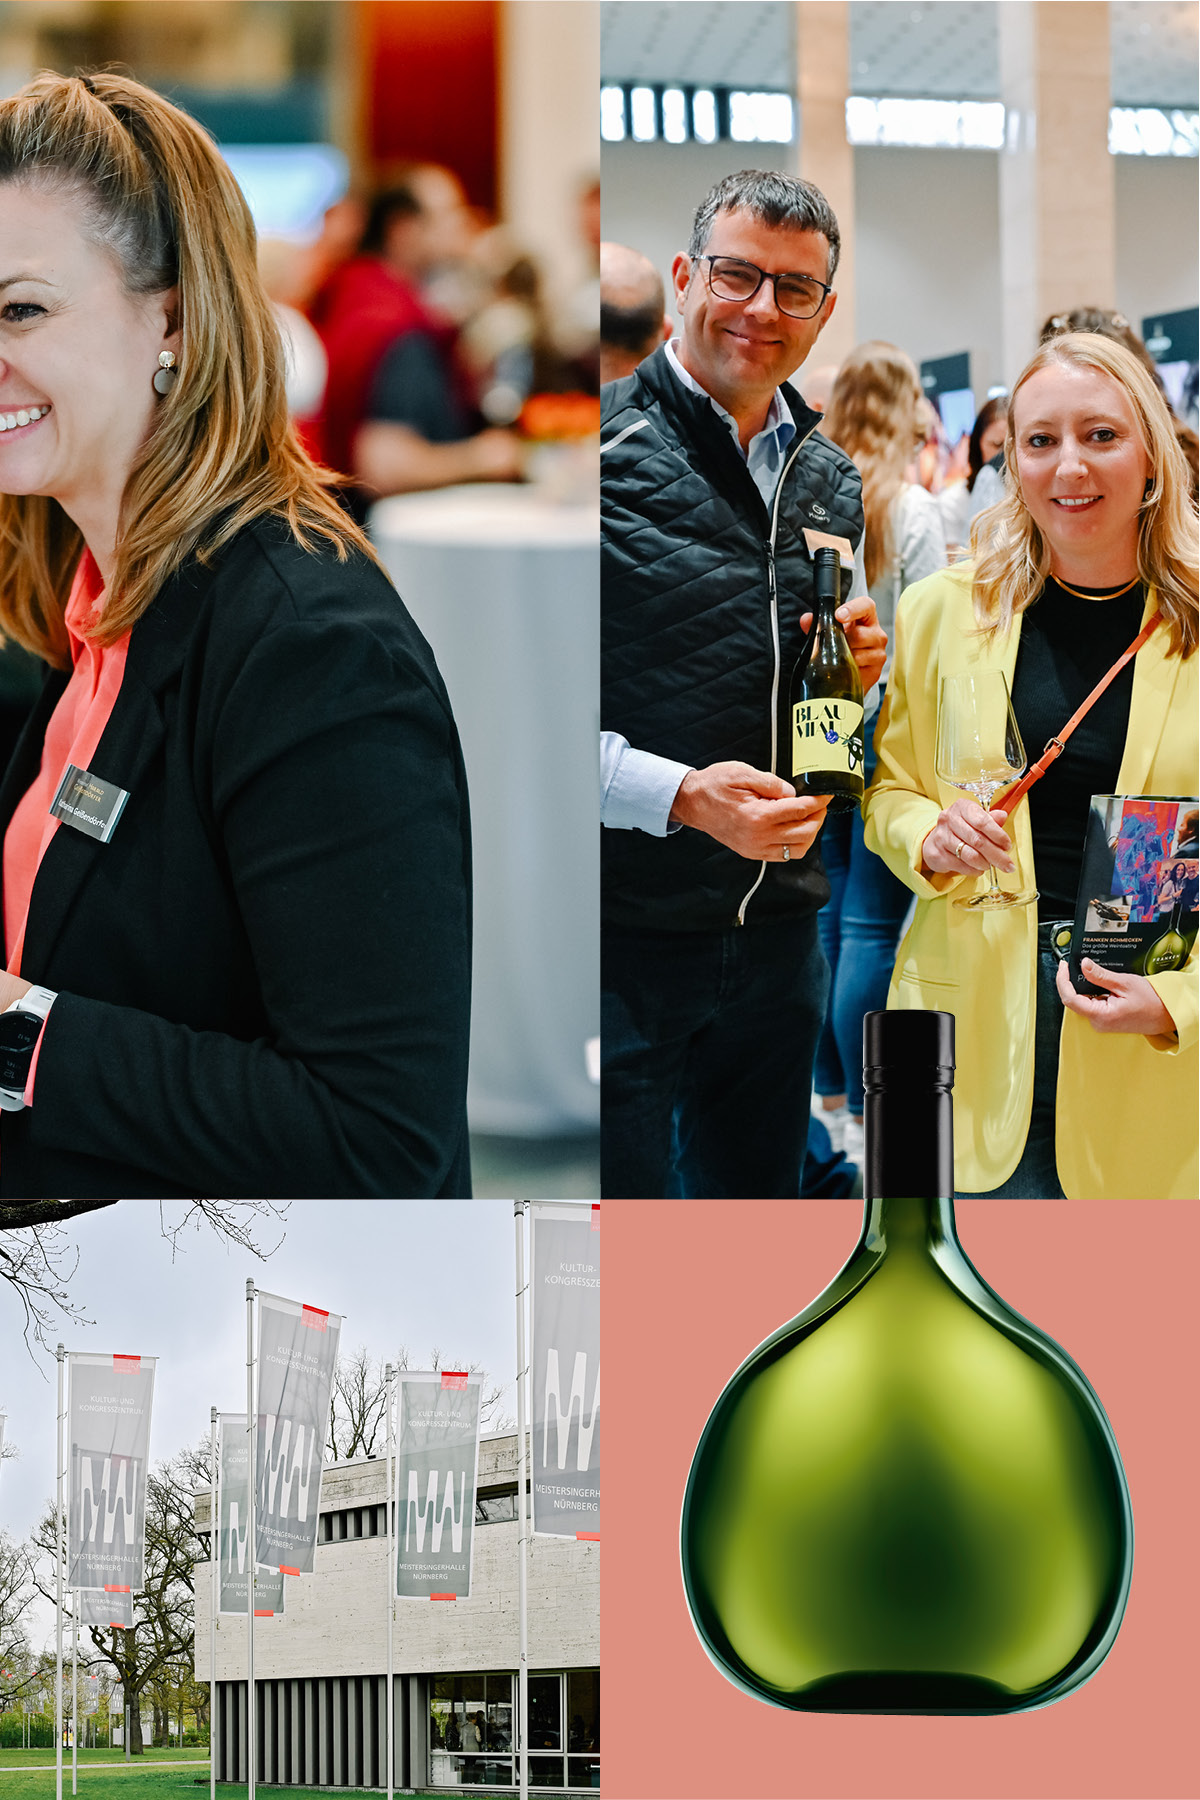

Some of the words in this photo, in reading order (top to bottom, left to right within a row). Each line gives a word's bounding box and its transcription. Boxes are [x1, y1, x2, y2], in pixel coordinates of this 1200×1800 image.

[796, 704, 846, 724] BLAU
[559, 1262, 597, 1273] KULTUR-
[407, 1420, 472, 1429] KONGRESSZENTRUM
[535, 1483, 600, 1498] MEISTERSINGERH
[553, 1498, 598, 1512] NÜRNBERG
[399, 1563, 467, 1571] MEISTERSINGERHALLE
[412, 1572, 449, 1580] NÜRNBERG
